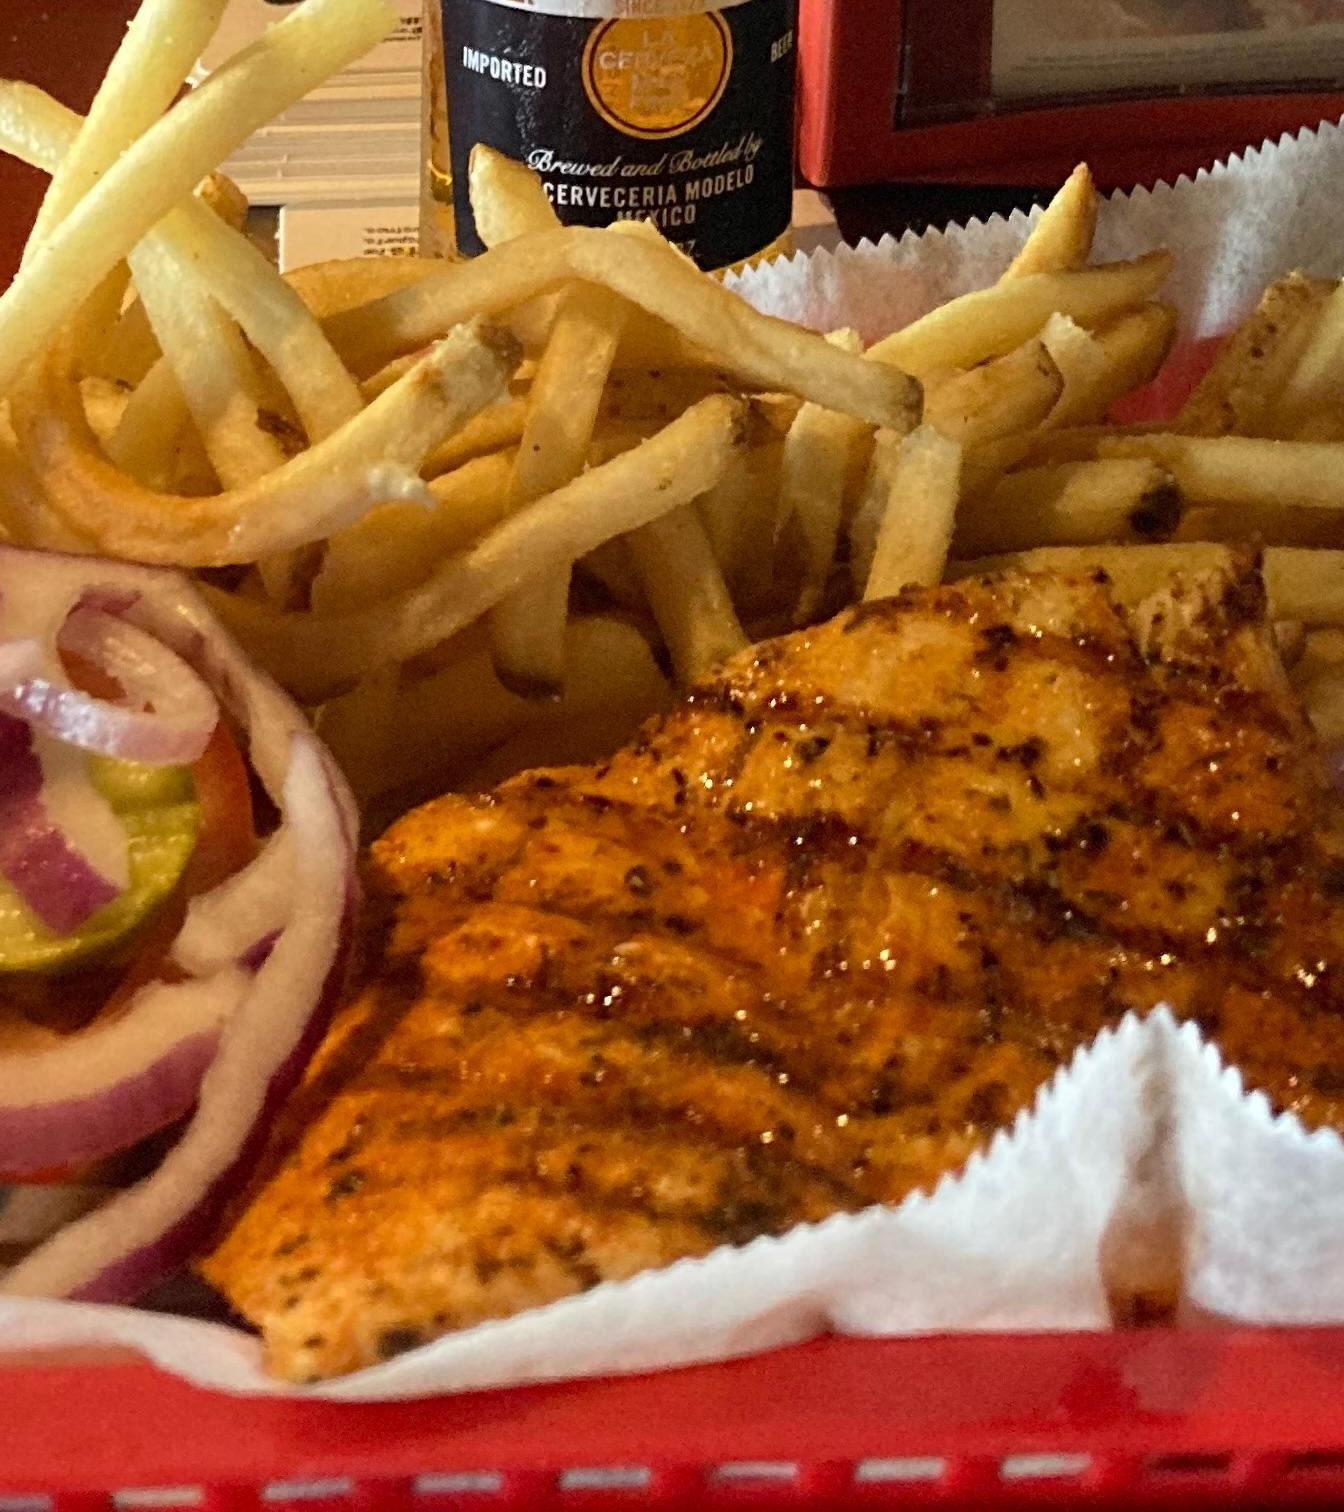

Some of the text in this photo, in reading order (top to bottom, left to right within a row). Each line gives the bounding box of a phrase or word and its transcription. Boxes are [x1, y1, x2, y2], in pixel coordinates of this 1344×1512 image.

[463, 46, 547, 88] IMPORTED
[528, 148, 620, 178] Brewed
[620, 151, 667, 178] and
[668, 142, 744, 175] Bottled
[543, 164, 754, 208] CERVECERIA MODELO
